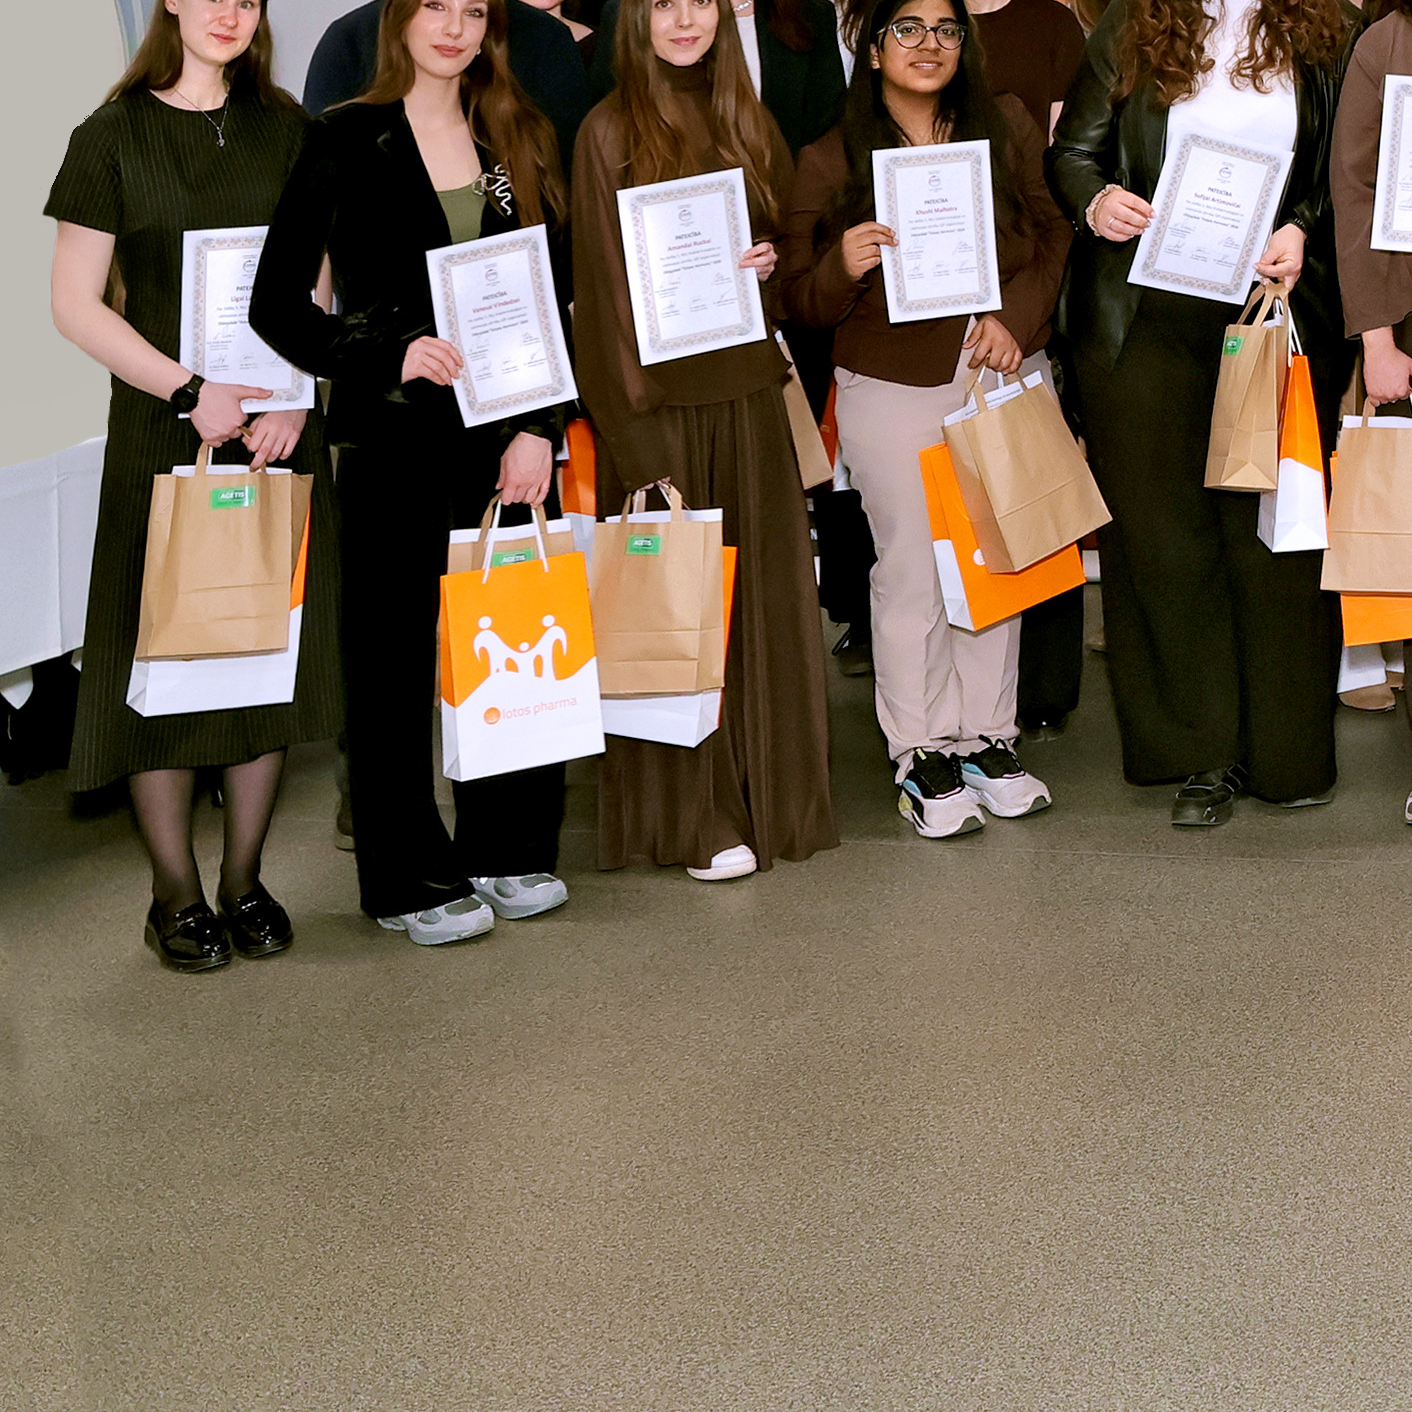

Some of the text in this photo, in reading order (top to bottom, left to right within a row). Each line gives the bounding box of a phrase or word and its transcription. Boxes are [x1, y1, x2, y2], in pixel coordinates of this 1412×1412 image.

[220, 491, 245, 500] AGETIS
[502, 697, 577, 719] lotos pharma
